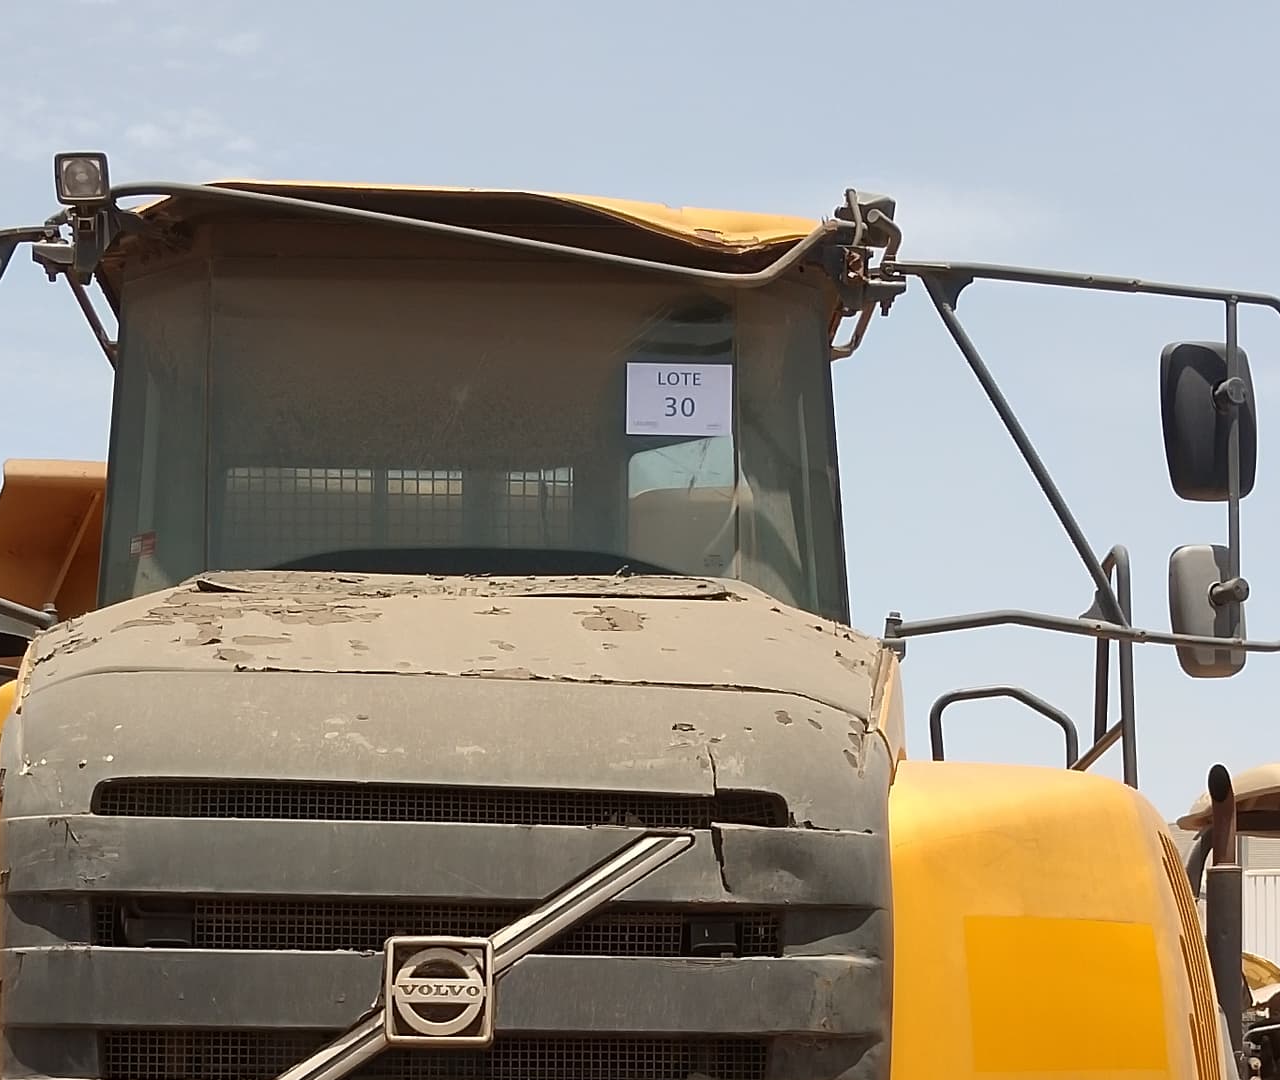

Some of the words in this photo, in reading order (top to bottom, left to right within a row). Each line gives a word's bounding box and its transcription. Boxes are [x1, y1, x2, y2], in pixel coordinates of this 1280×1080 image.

[658, 372, 702, 386] LOTE
[664, 397, 696, 417] 30
[398, 984, 481, 997] VOLVO
